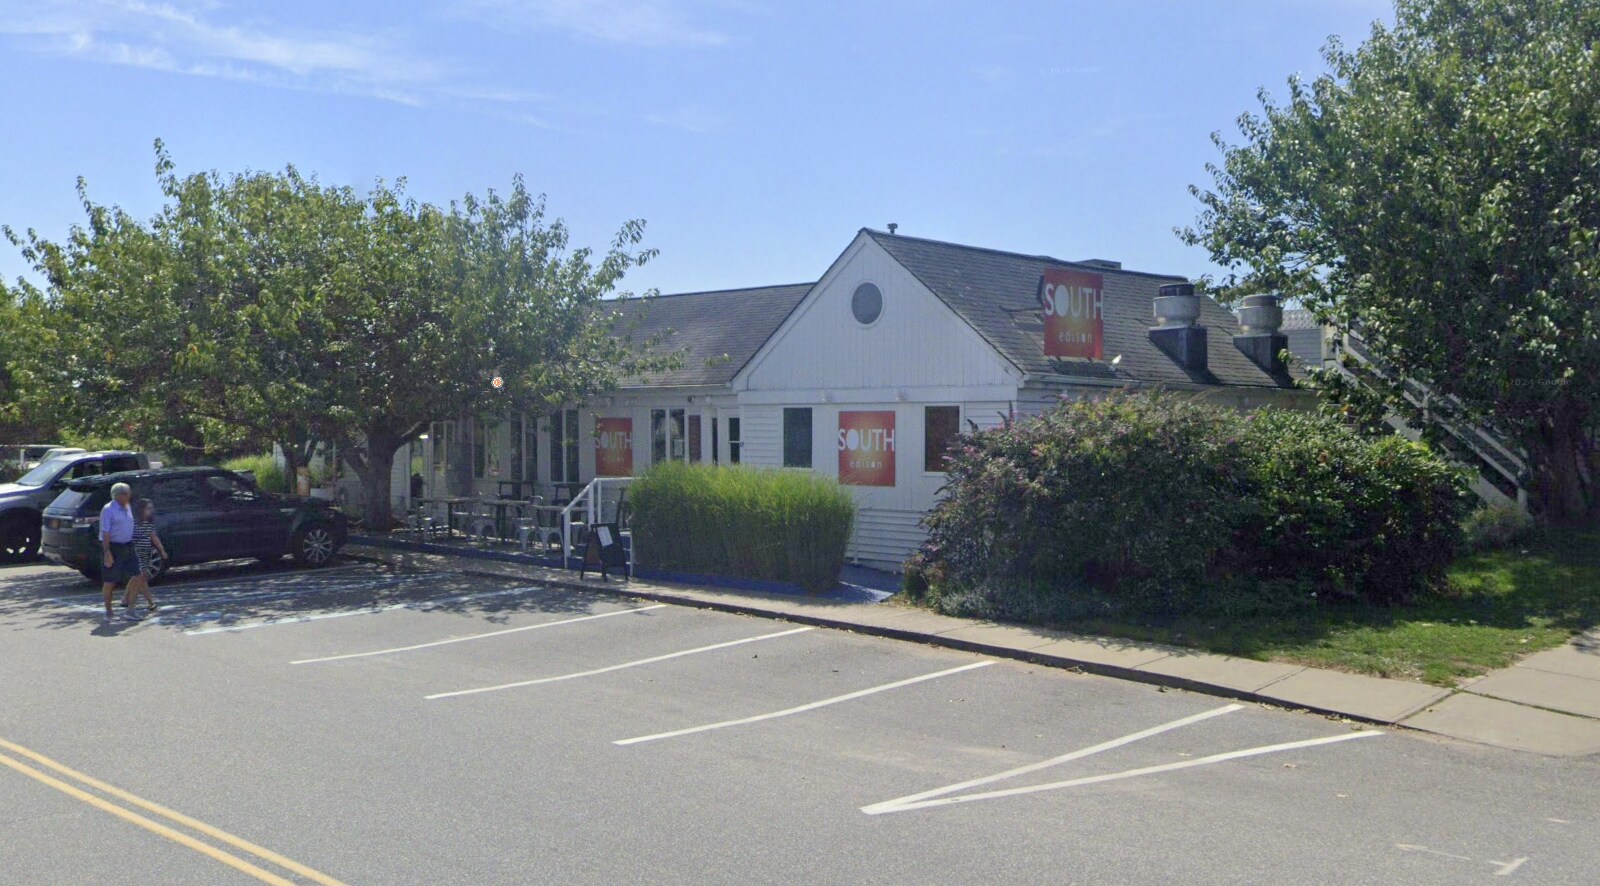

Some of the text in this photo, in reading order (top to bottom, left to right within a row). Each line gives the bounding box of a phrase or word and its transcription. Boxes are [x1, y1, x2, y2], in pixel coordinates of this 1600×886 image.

[1043, 283, 1104, 320] SOUTH
[1058, 330, 1093, 344] edison
[838, 428, 895, 452] SOUTH
